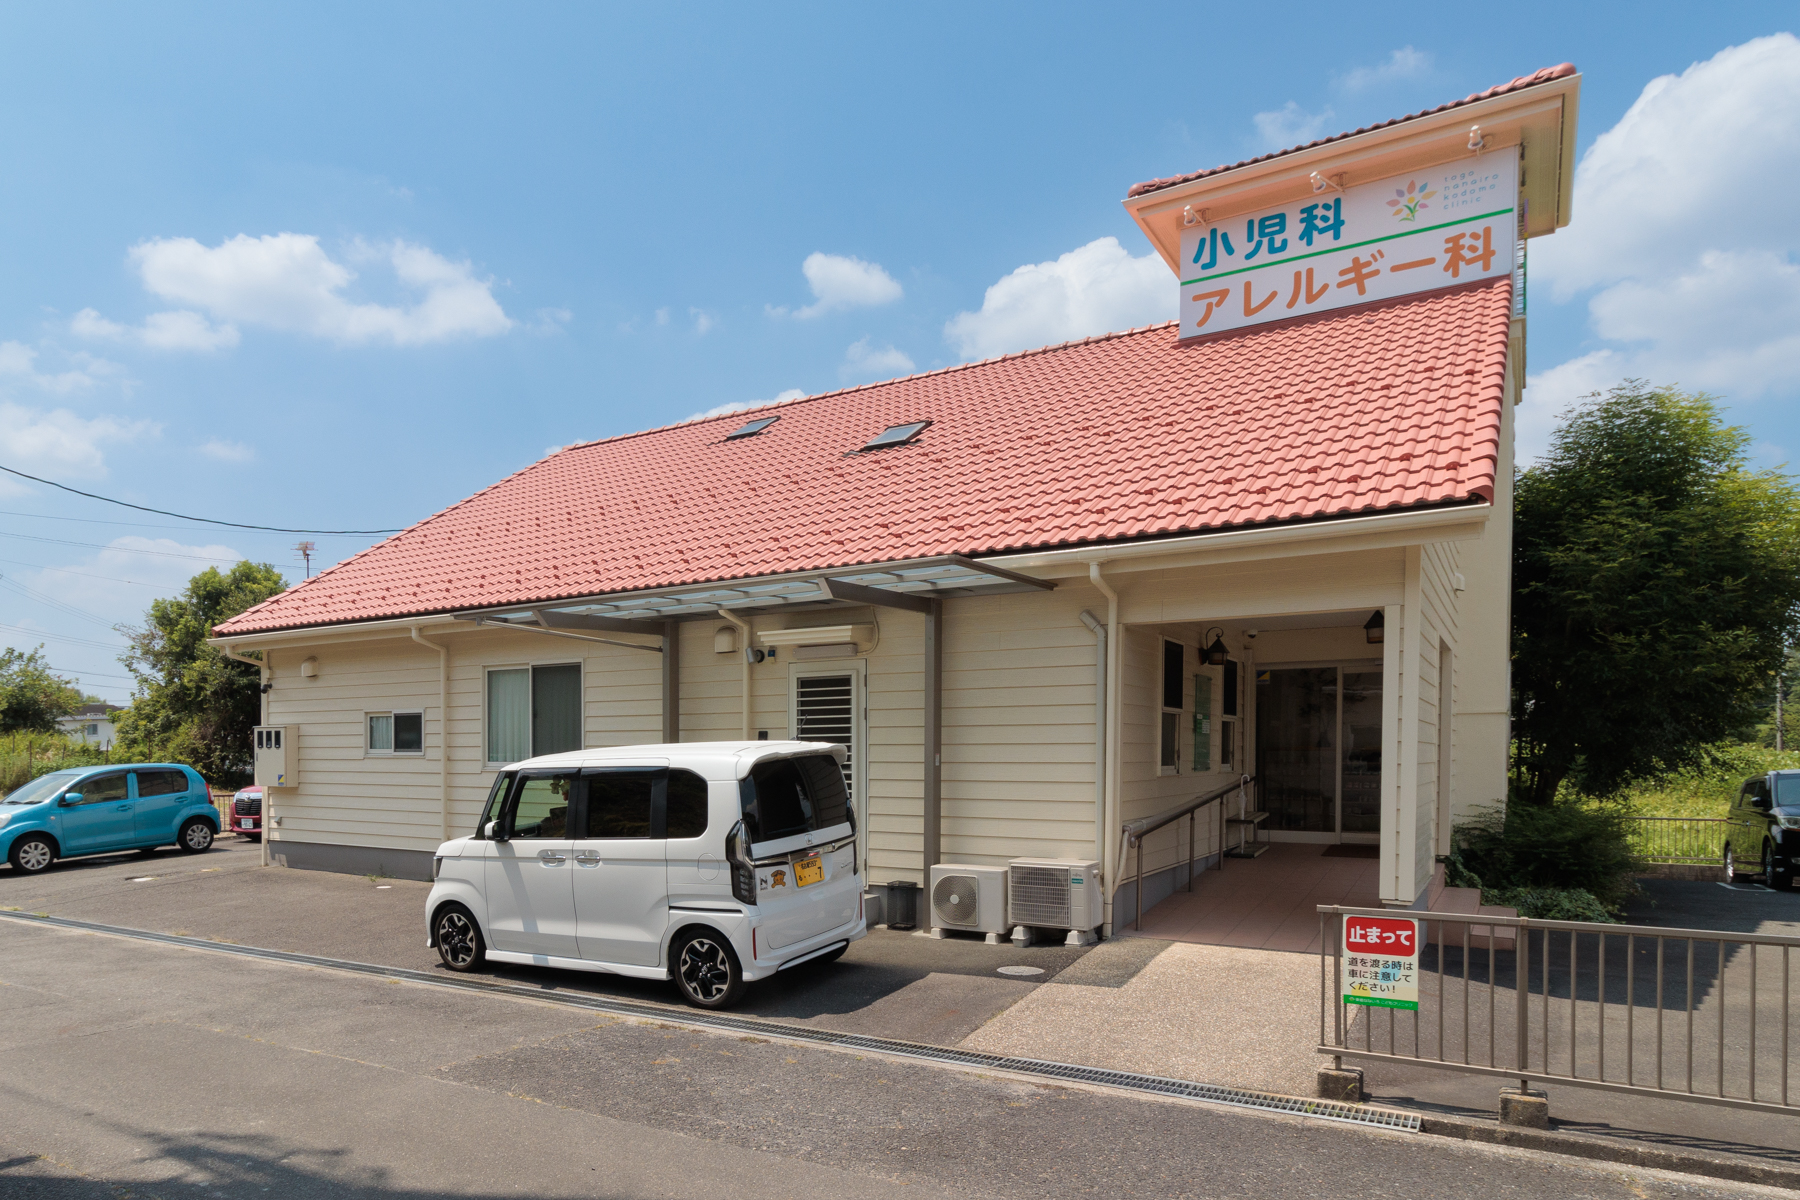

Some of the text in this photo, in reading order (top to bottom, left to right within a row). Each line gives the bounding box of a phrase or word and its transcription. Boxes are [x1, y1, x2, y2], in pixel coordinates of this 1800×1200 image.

[1444, 171, 1475, 182] togo
[1444, 174, 1499, 192] nanairo
[1443, 184, 1496, 201] kodomo
[1443, 196, 1482, 210] clinic
[1192, 197, 1346, 270] 小児科
[1192, 226, 1497, 328] アレルギー科
[1348, 926, 1412, 946] 止まって
[1347, 957, 1414, 971] 道を渡る時は
[1347, 968, 1412, 983] 車に注意して
